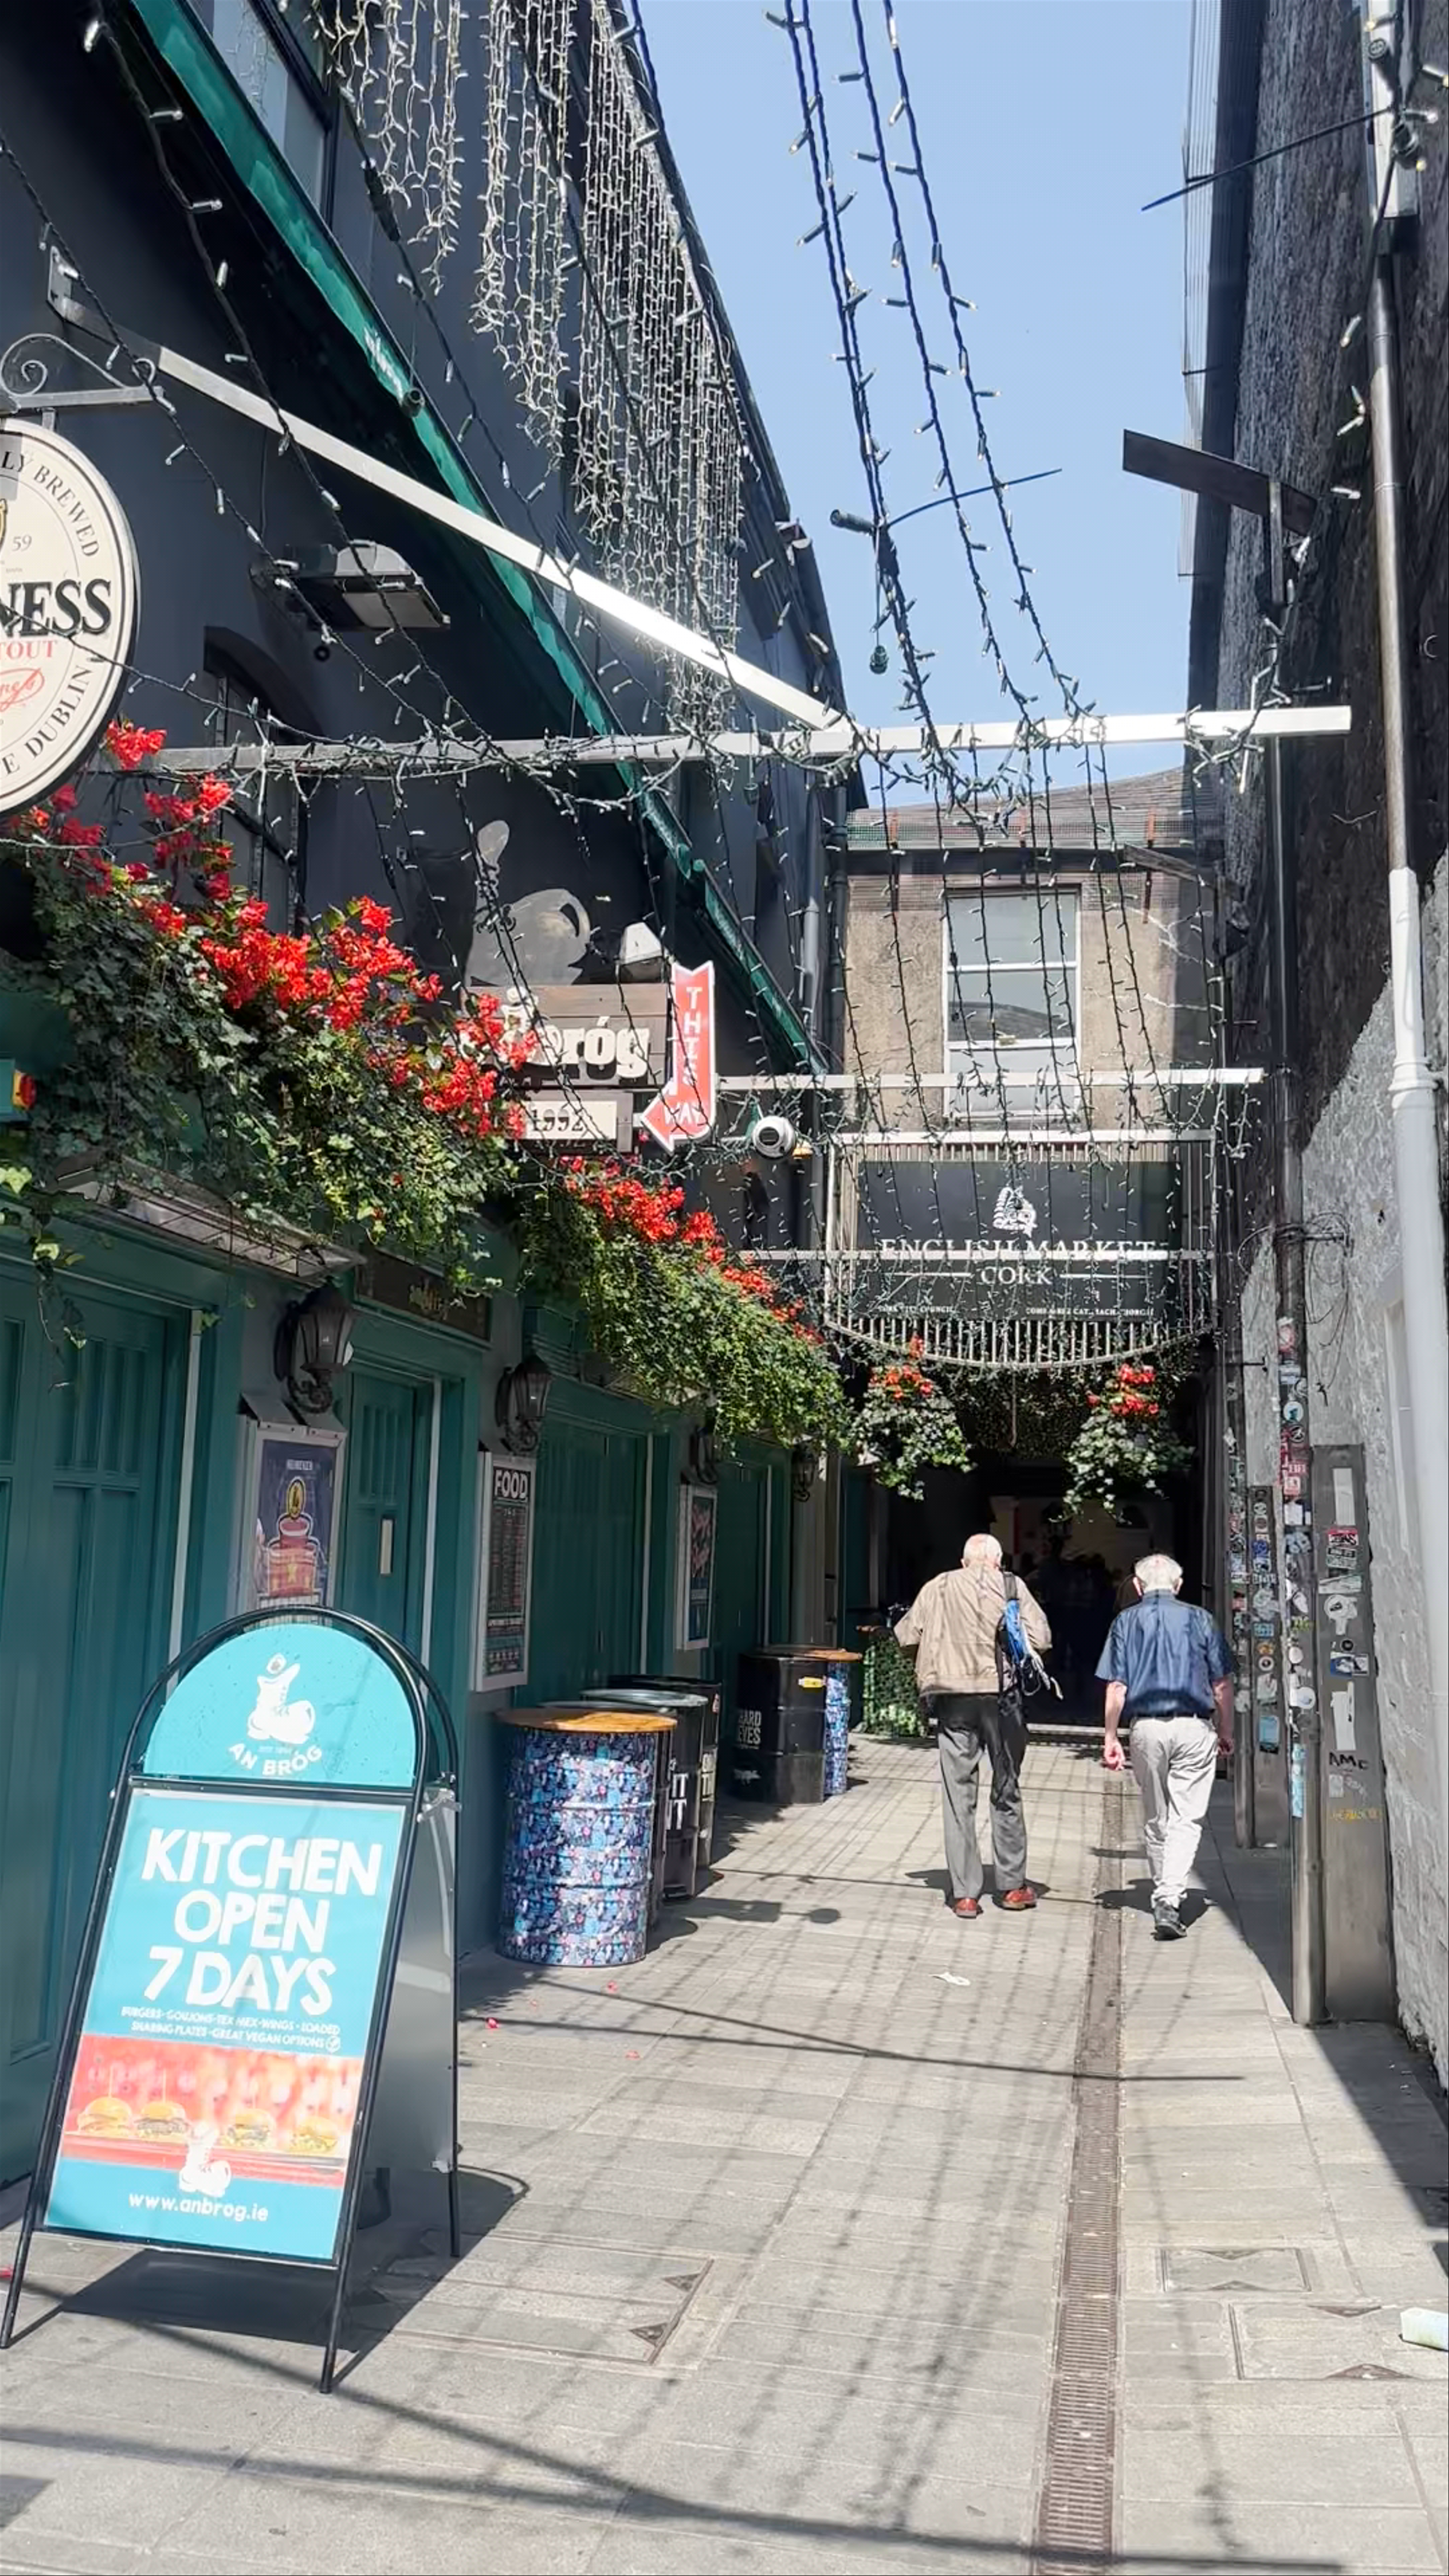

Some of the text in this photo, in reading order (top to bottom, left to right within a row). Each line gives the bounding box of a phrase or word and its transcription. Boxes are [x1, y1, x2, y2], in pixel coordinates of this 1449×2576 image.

[34, 466, 99, 557] BREWED
[24, 666, 92, 757] DUBLIN
[981, 1266, 1052, 1284] CORK
[494, 1470, 528, 1499] FOOD
[229, 1743, 322, 1775] AN BRÓG
[141, 1827, 383, 1896] KITCHEN
[174, 1889, 330, 1953] OPEN
[144, 1945, 337, 2016] 7 DAYS
[246, 2032, 281, 2044] VEGAN
[282, 2035, 325, 2048] OPTIONS
[261, 2019, 294, 2031] WINGS
[301, 2022, 340, 2035] LOADED
[128, 2193, 268, 2222] www.anbrog.ie
